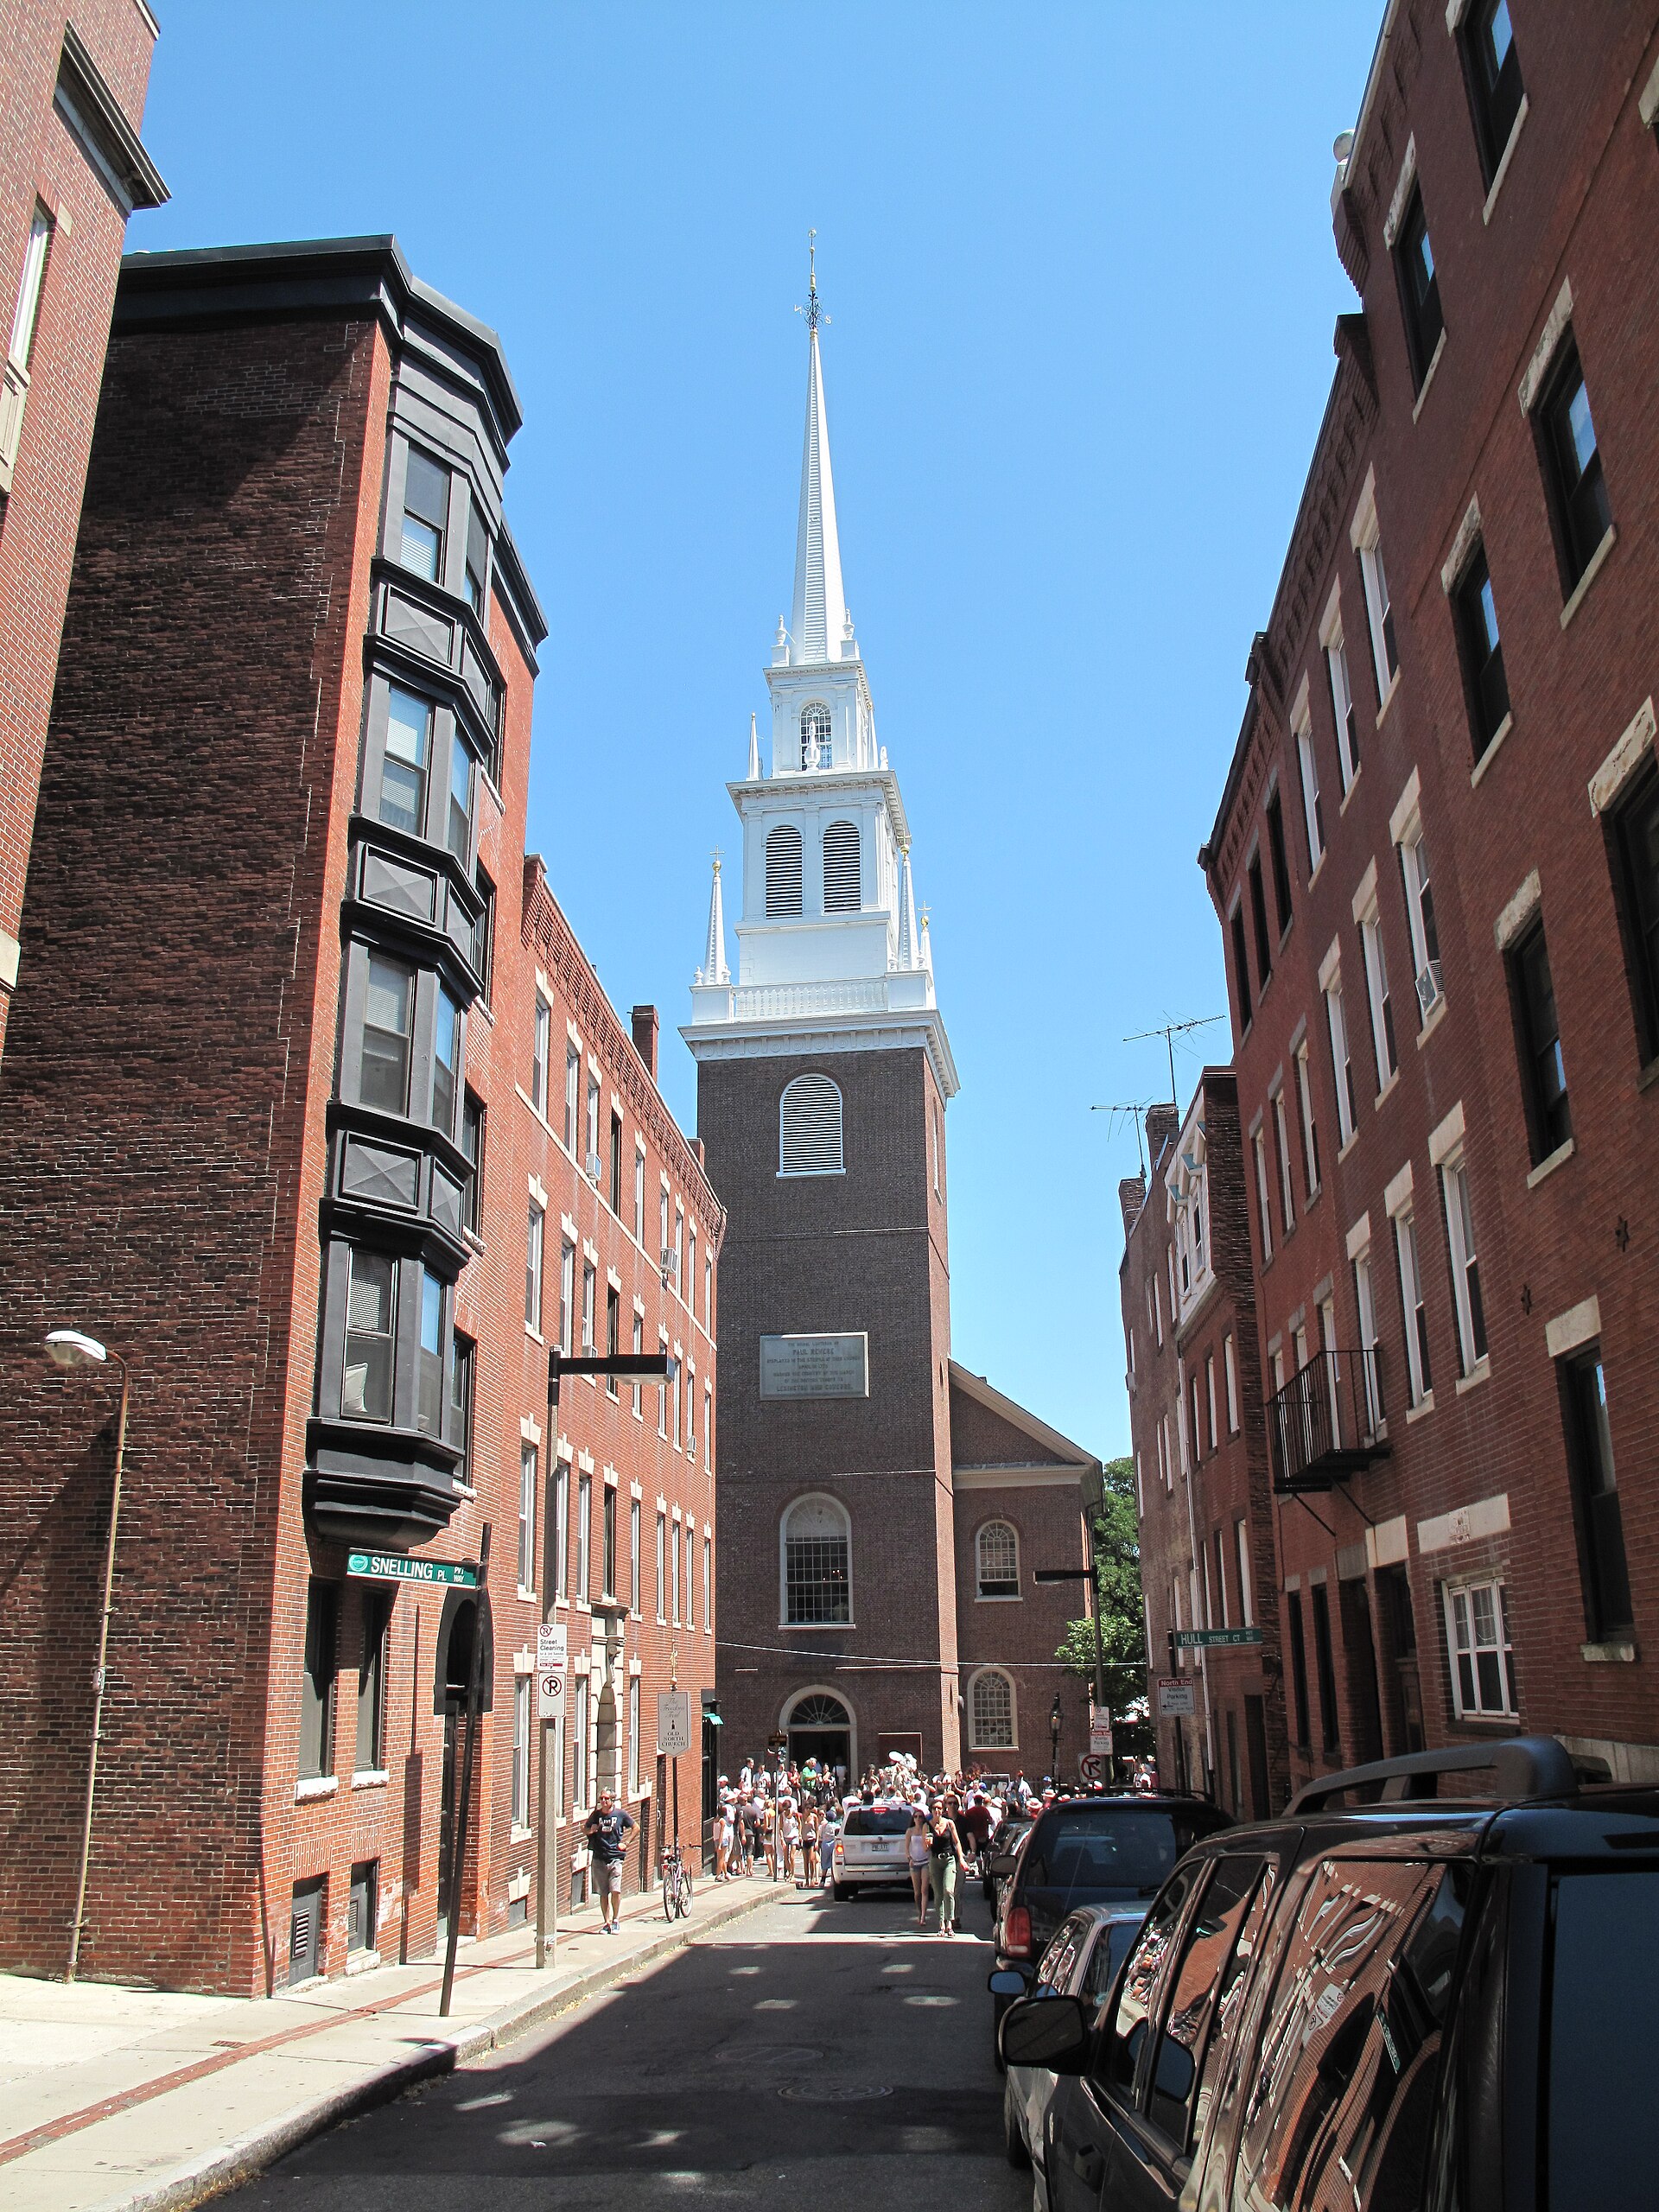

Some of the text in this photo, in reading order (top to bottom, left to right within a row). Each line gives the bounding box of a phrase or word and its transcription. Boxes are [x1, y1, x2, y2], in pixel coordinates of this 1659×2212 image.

[370, 1556, 434, 1580] SNELLING
[436, 1570, 448, 1581] PL
[1180, 1633, 1203, 1645] HULL
[1208, 1635, 1229, 1643] STREET
